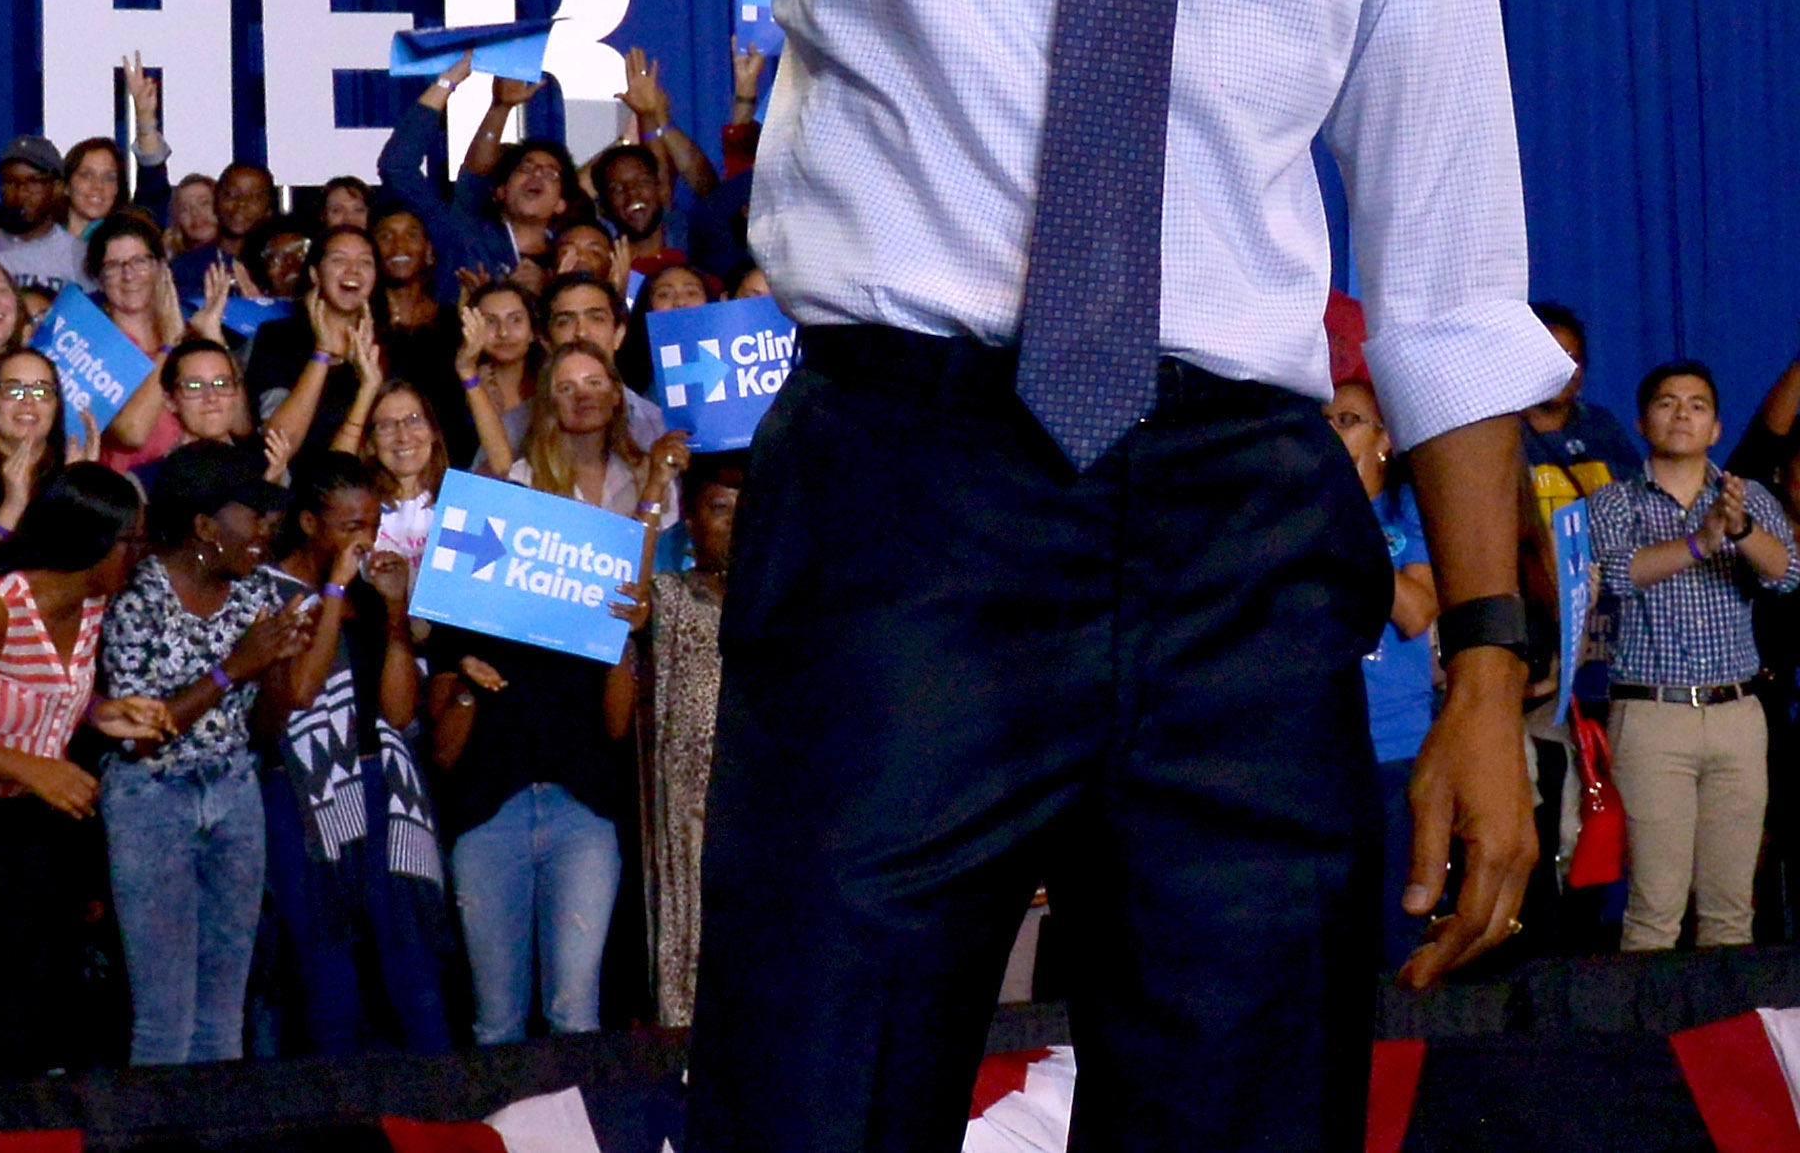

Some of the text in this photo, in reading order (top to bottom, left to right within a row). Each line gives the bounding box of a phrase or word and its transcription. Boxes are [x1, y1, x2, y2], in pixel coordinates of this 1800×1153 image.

[55, 330, 126, 405] Clinton
[512, 526, 633, 582] Clinton
[504, 557, 605, 608] Kaine
